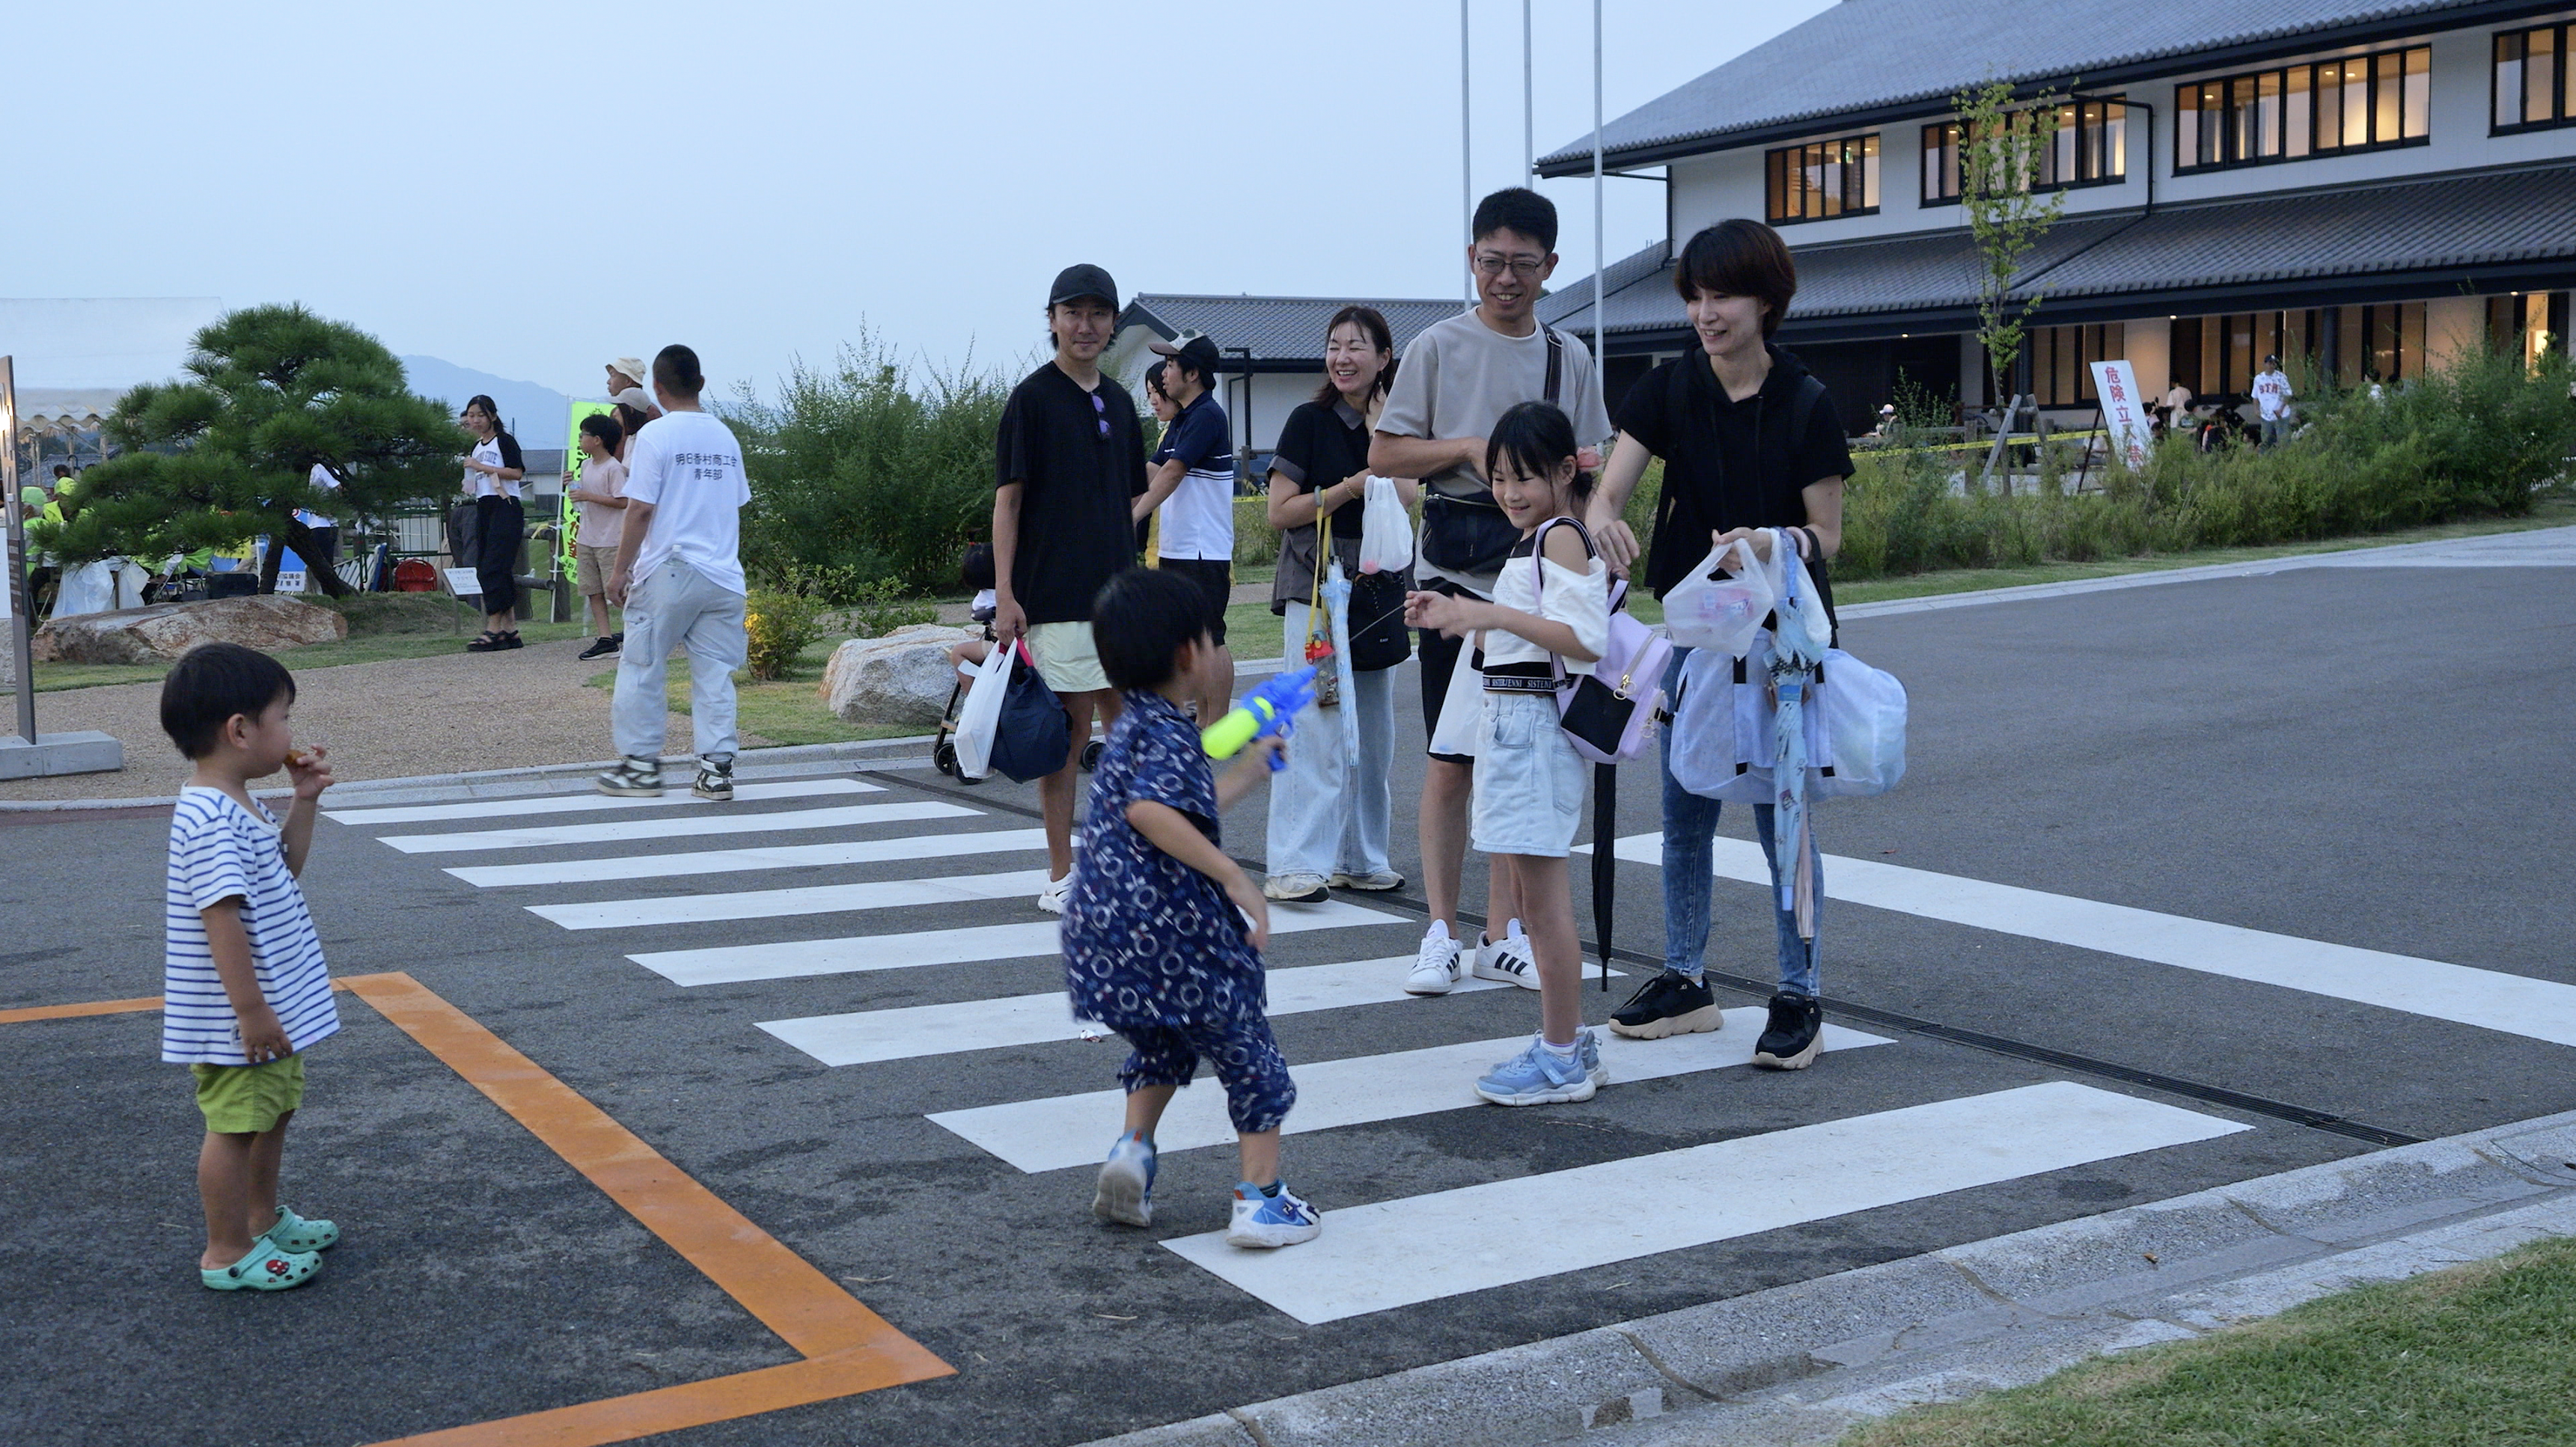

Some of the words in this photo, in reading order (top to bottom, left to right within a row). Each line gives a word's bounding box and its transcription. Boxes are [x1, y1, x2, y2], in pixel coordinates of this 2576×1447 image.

[675, 453, 737, 467] 明日香村商工会
[695, 468, 723, 480] 青年部
